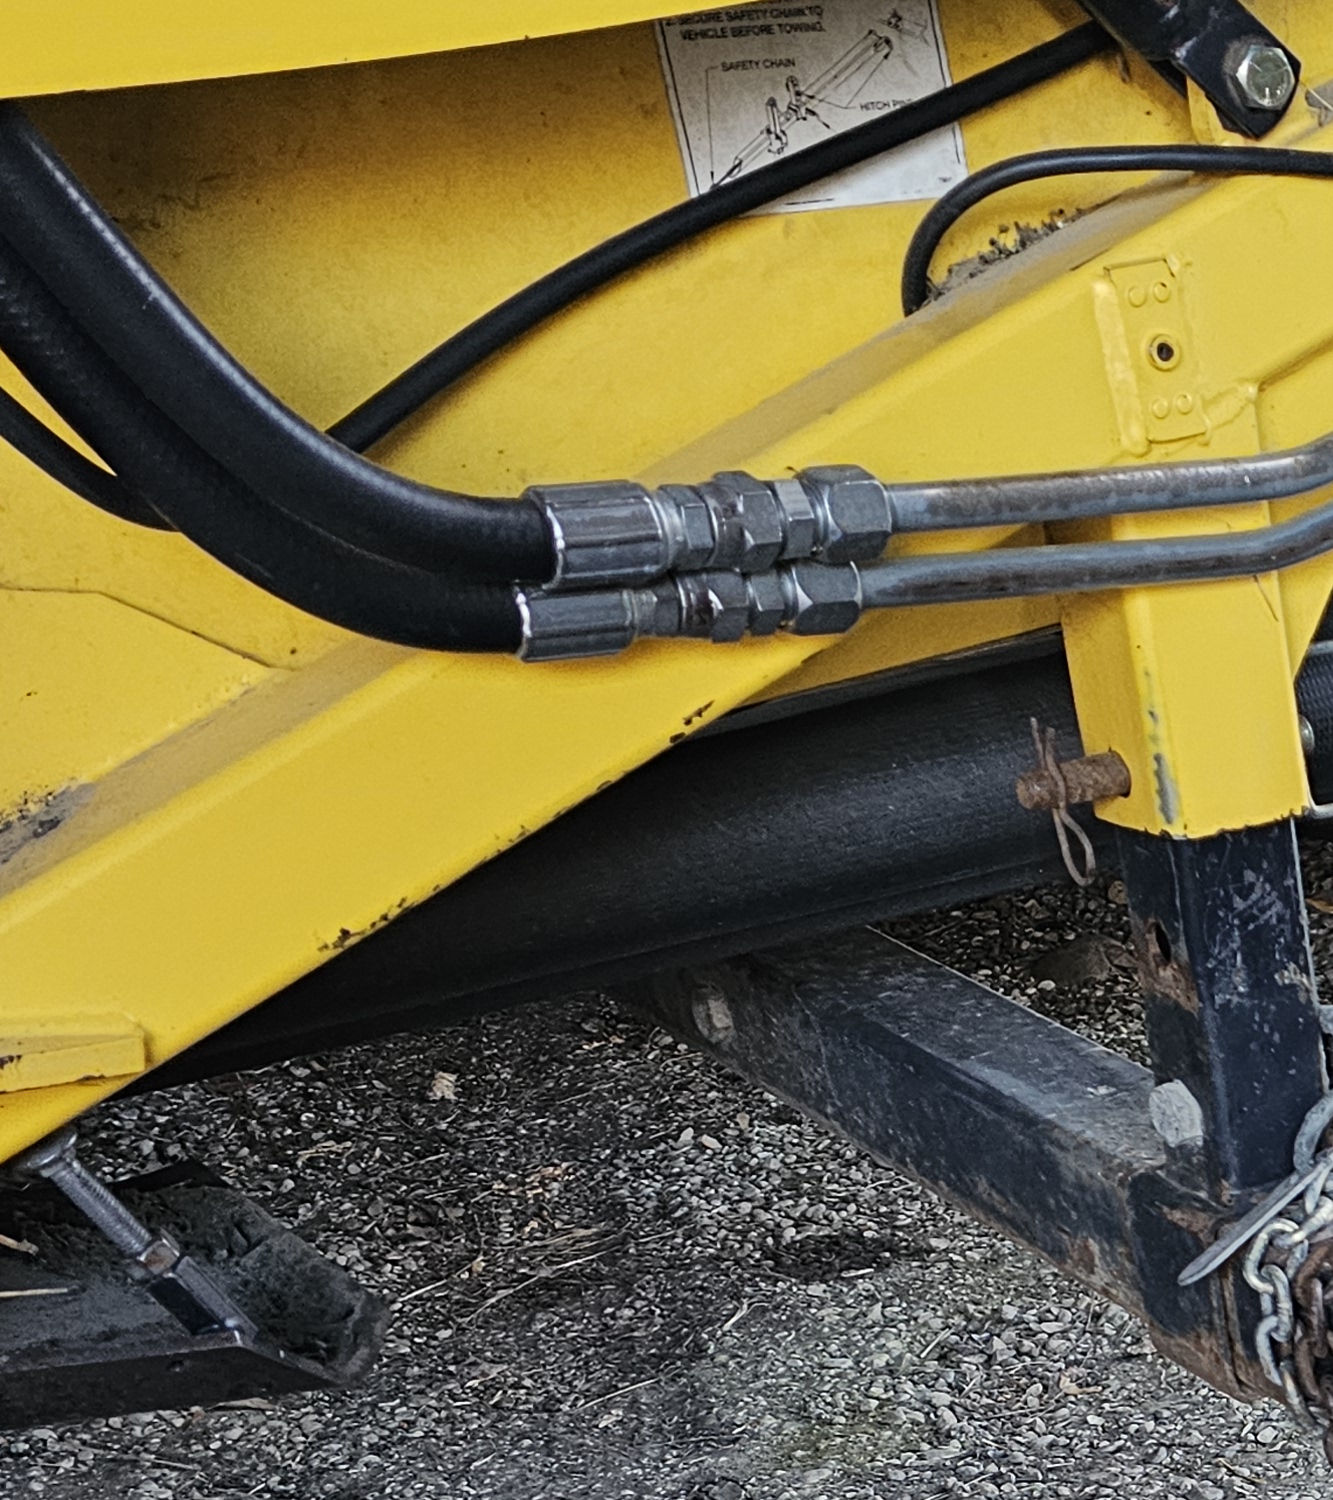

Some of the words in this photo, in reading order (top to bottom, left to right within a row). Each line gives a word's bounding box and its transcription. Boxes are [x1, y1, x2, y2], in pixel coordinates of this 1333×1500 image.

[724, 8, 768, 22] SAFETY
[680, 26, 728, 41] VEHICLE
[729, 24, 776, 37] BEFORE
[720, 60, 760, 73] SAFETY
[761, 57, 796, 69] CHAIN
[859, 100, 890, 111] HITCH
